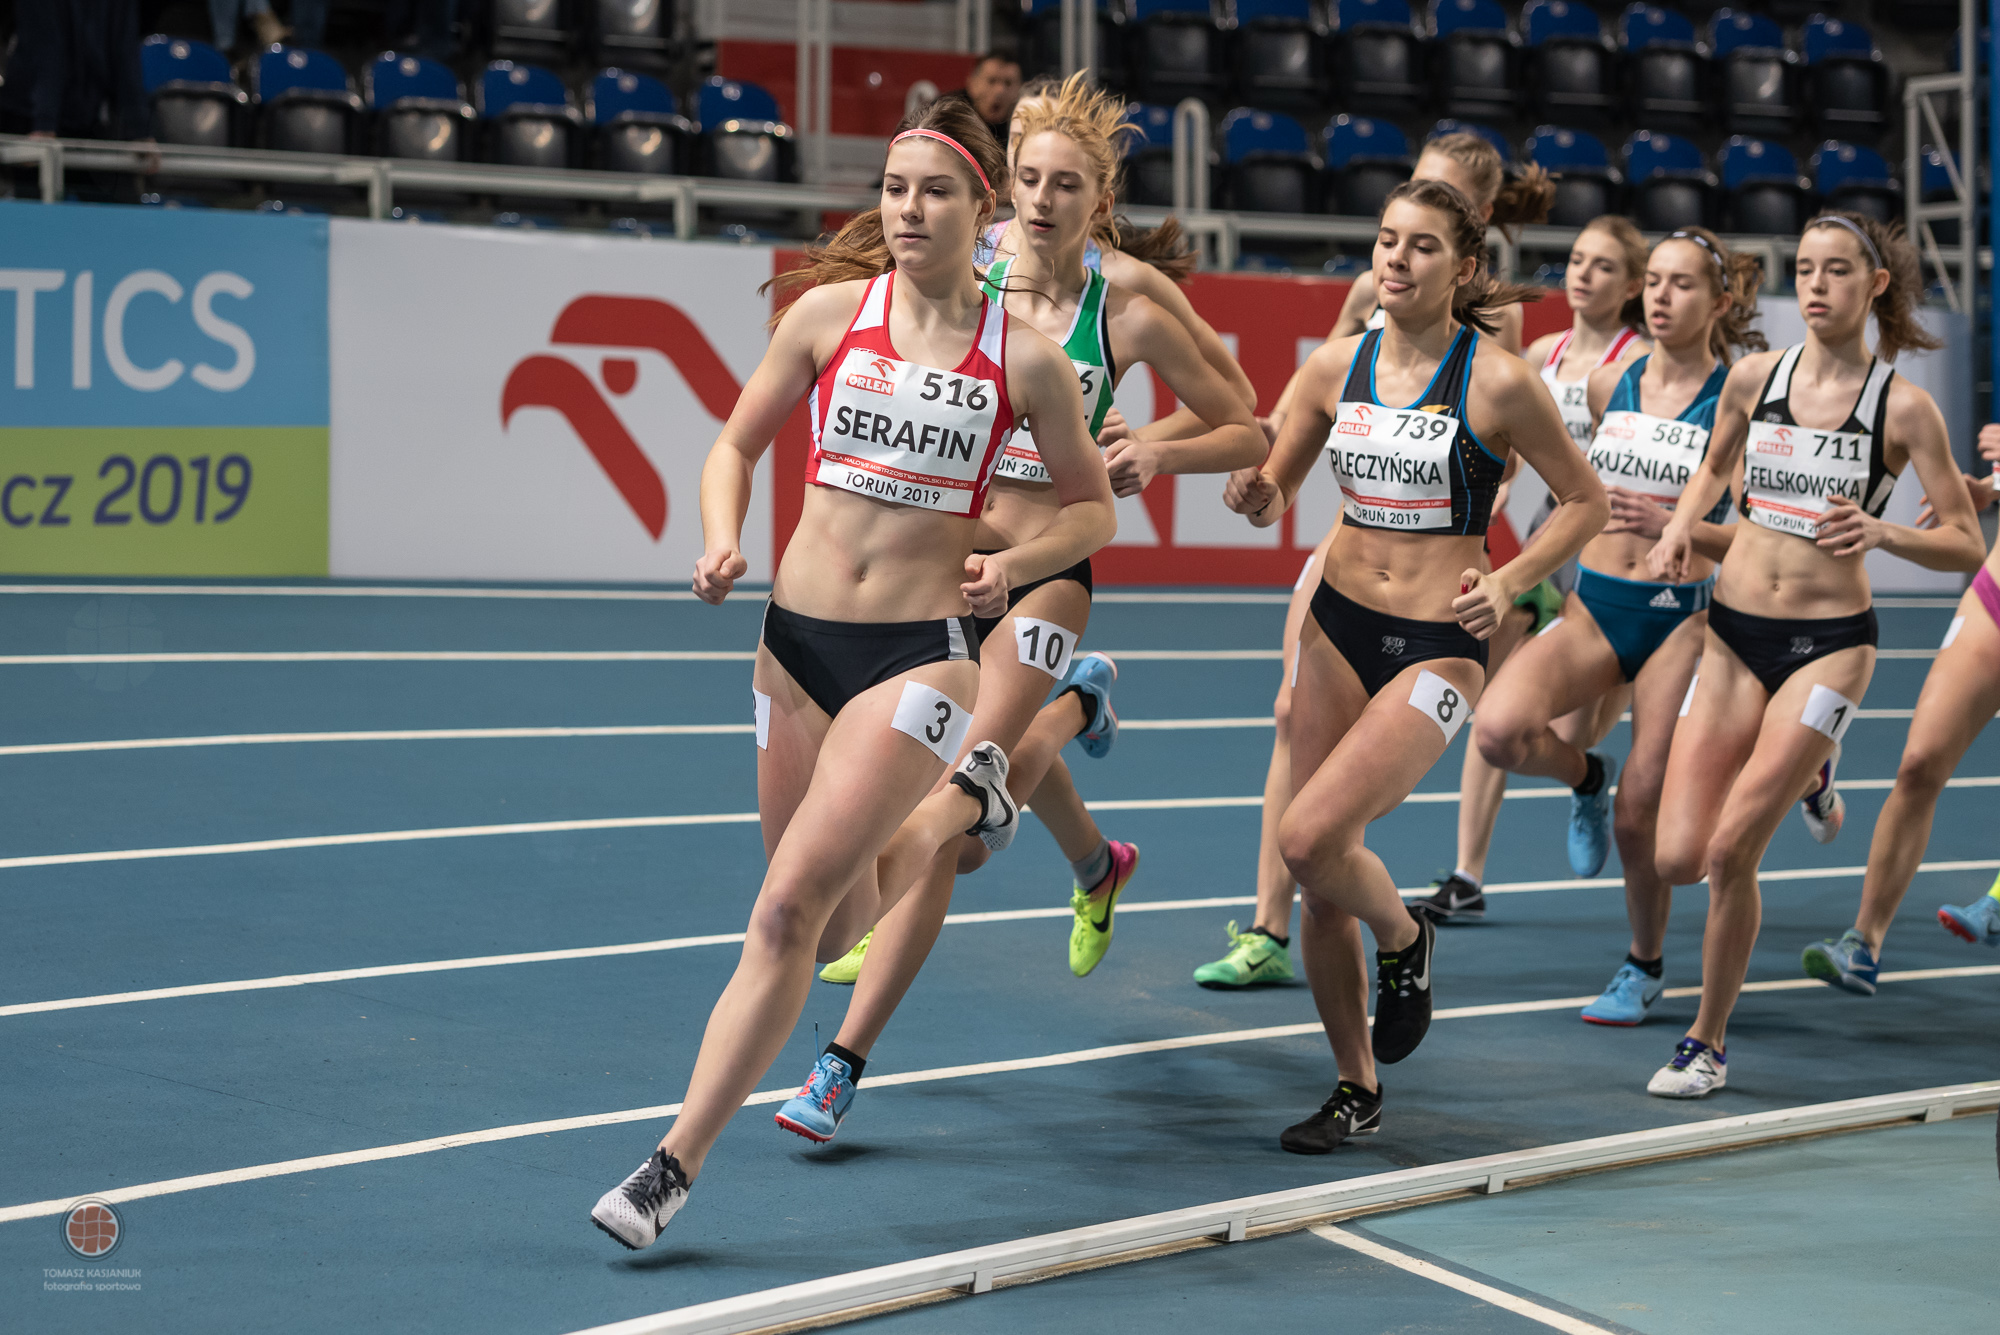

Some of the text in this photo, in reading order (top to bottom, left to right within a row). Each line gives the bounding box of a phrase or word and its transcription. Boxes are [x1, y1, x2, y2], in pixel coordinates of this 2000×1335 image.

[848, 375, 892, 394] ORLEN
[920, 372, 988, 411] 516
[833, 405, 977, 462] SERAFIN
[1338, 422, 1370, 436] ORLEN
[1393, 414, 1448, 441] 739
[1652, 423, 1698, 450] 581
[1813, 434, 1862, 462] 711
[825, 452, 844, 461] PZLA
[844, 457, 869, 468] HALOWE
[869, 464, 918, 481] MISTRZOSTWA
[918, 476, 942, 485] POLSKI
[1020, 463, 1050, 479] 201
[1330, 449, 1444, 485] PLECZYŃSKA
[1751, 466, 1860, 500] FELSKOWSKA
[93, 454, 252, 526] 2019
[845, 471, 941, 505] TORUŃ 2019
[1353, 505, 1421, 525] TORUŃ 2019
[1768, 513, 1805, 531] TORUŃ
[1023, 625, 1064, 671] 10
[925, 700, 952, 744] 3
[1437, 689, 1459, 723] 8
[1831, 705, 1847, 735] 1
